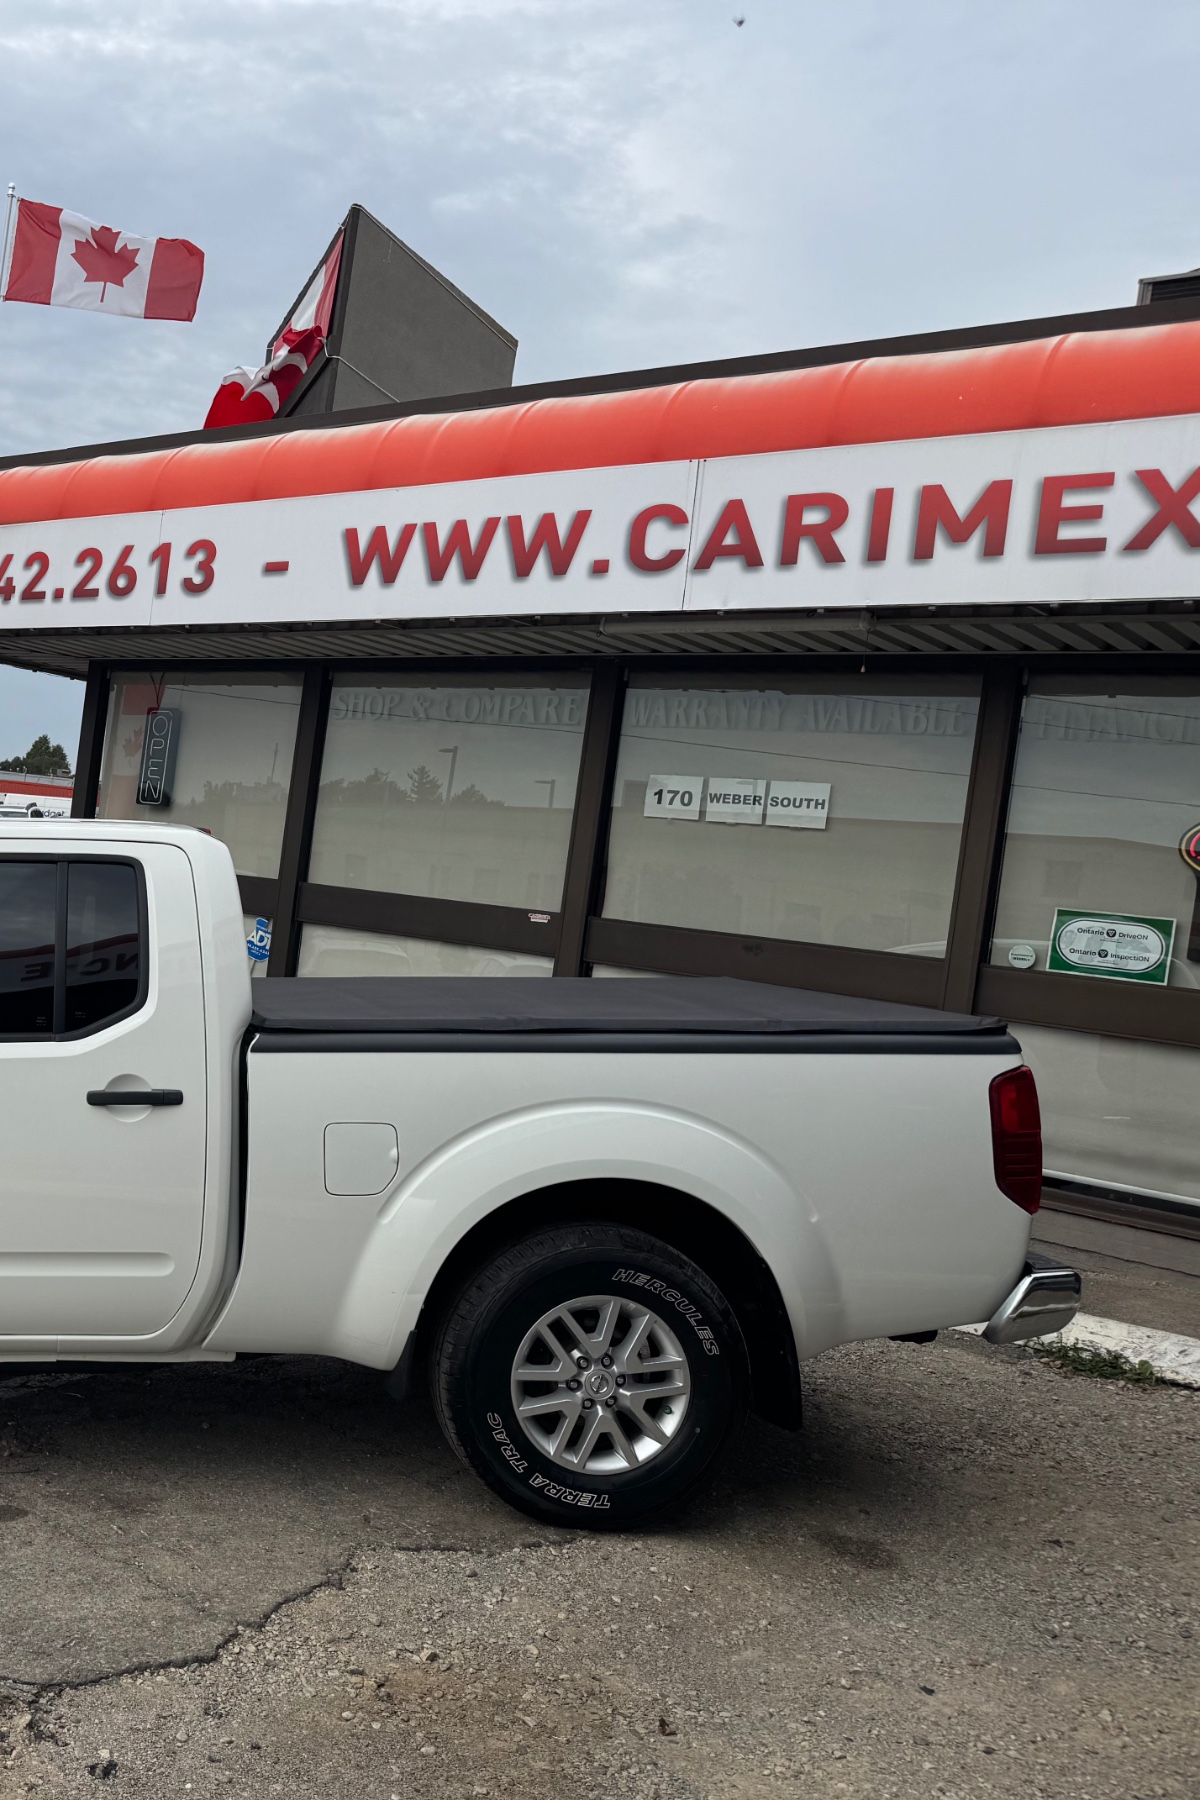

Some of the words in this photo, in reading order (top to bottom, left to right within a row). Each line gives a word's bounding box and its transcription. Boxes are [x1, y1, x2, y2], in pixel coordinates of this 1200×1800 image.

[332, 691, 399, 722] SHOP
[409, 692, 432, 721] &
[630, 696, 784, 730] WARRANTY
[145, 715, 169, 799] OPEN
[653, 788, 693, 808] 170
[708, 792, 763, 807] WEBER
[769, 795, 826, 811] SOUTH
[1077, 927, 1105, 937] Ontario
[1118, 931, 1149, 941] DriveON
[1069, 947, 1097, 957] Ontario
[1110, 952, 1150, 963] InspectiON
[611, 1268, 720, 1356] HERCULES
[486, 1411, 528, 1474] TRAC
[529, 1473, 611, 1509] TERRA
